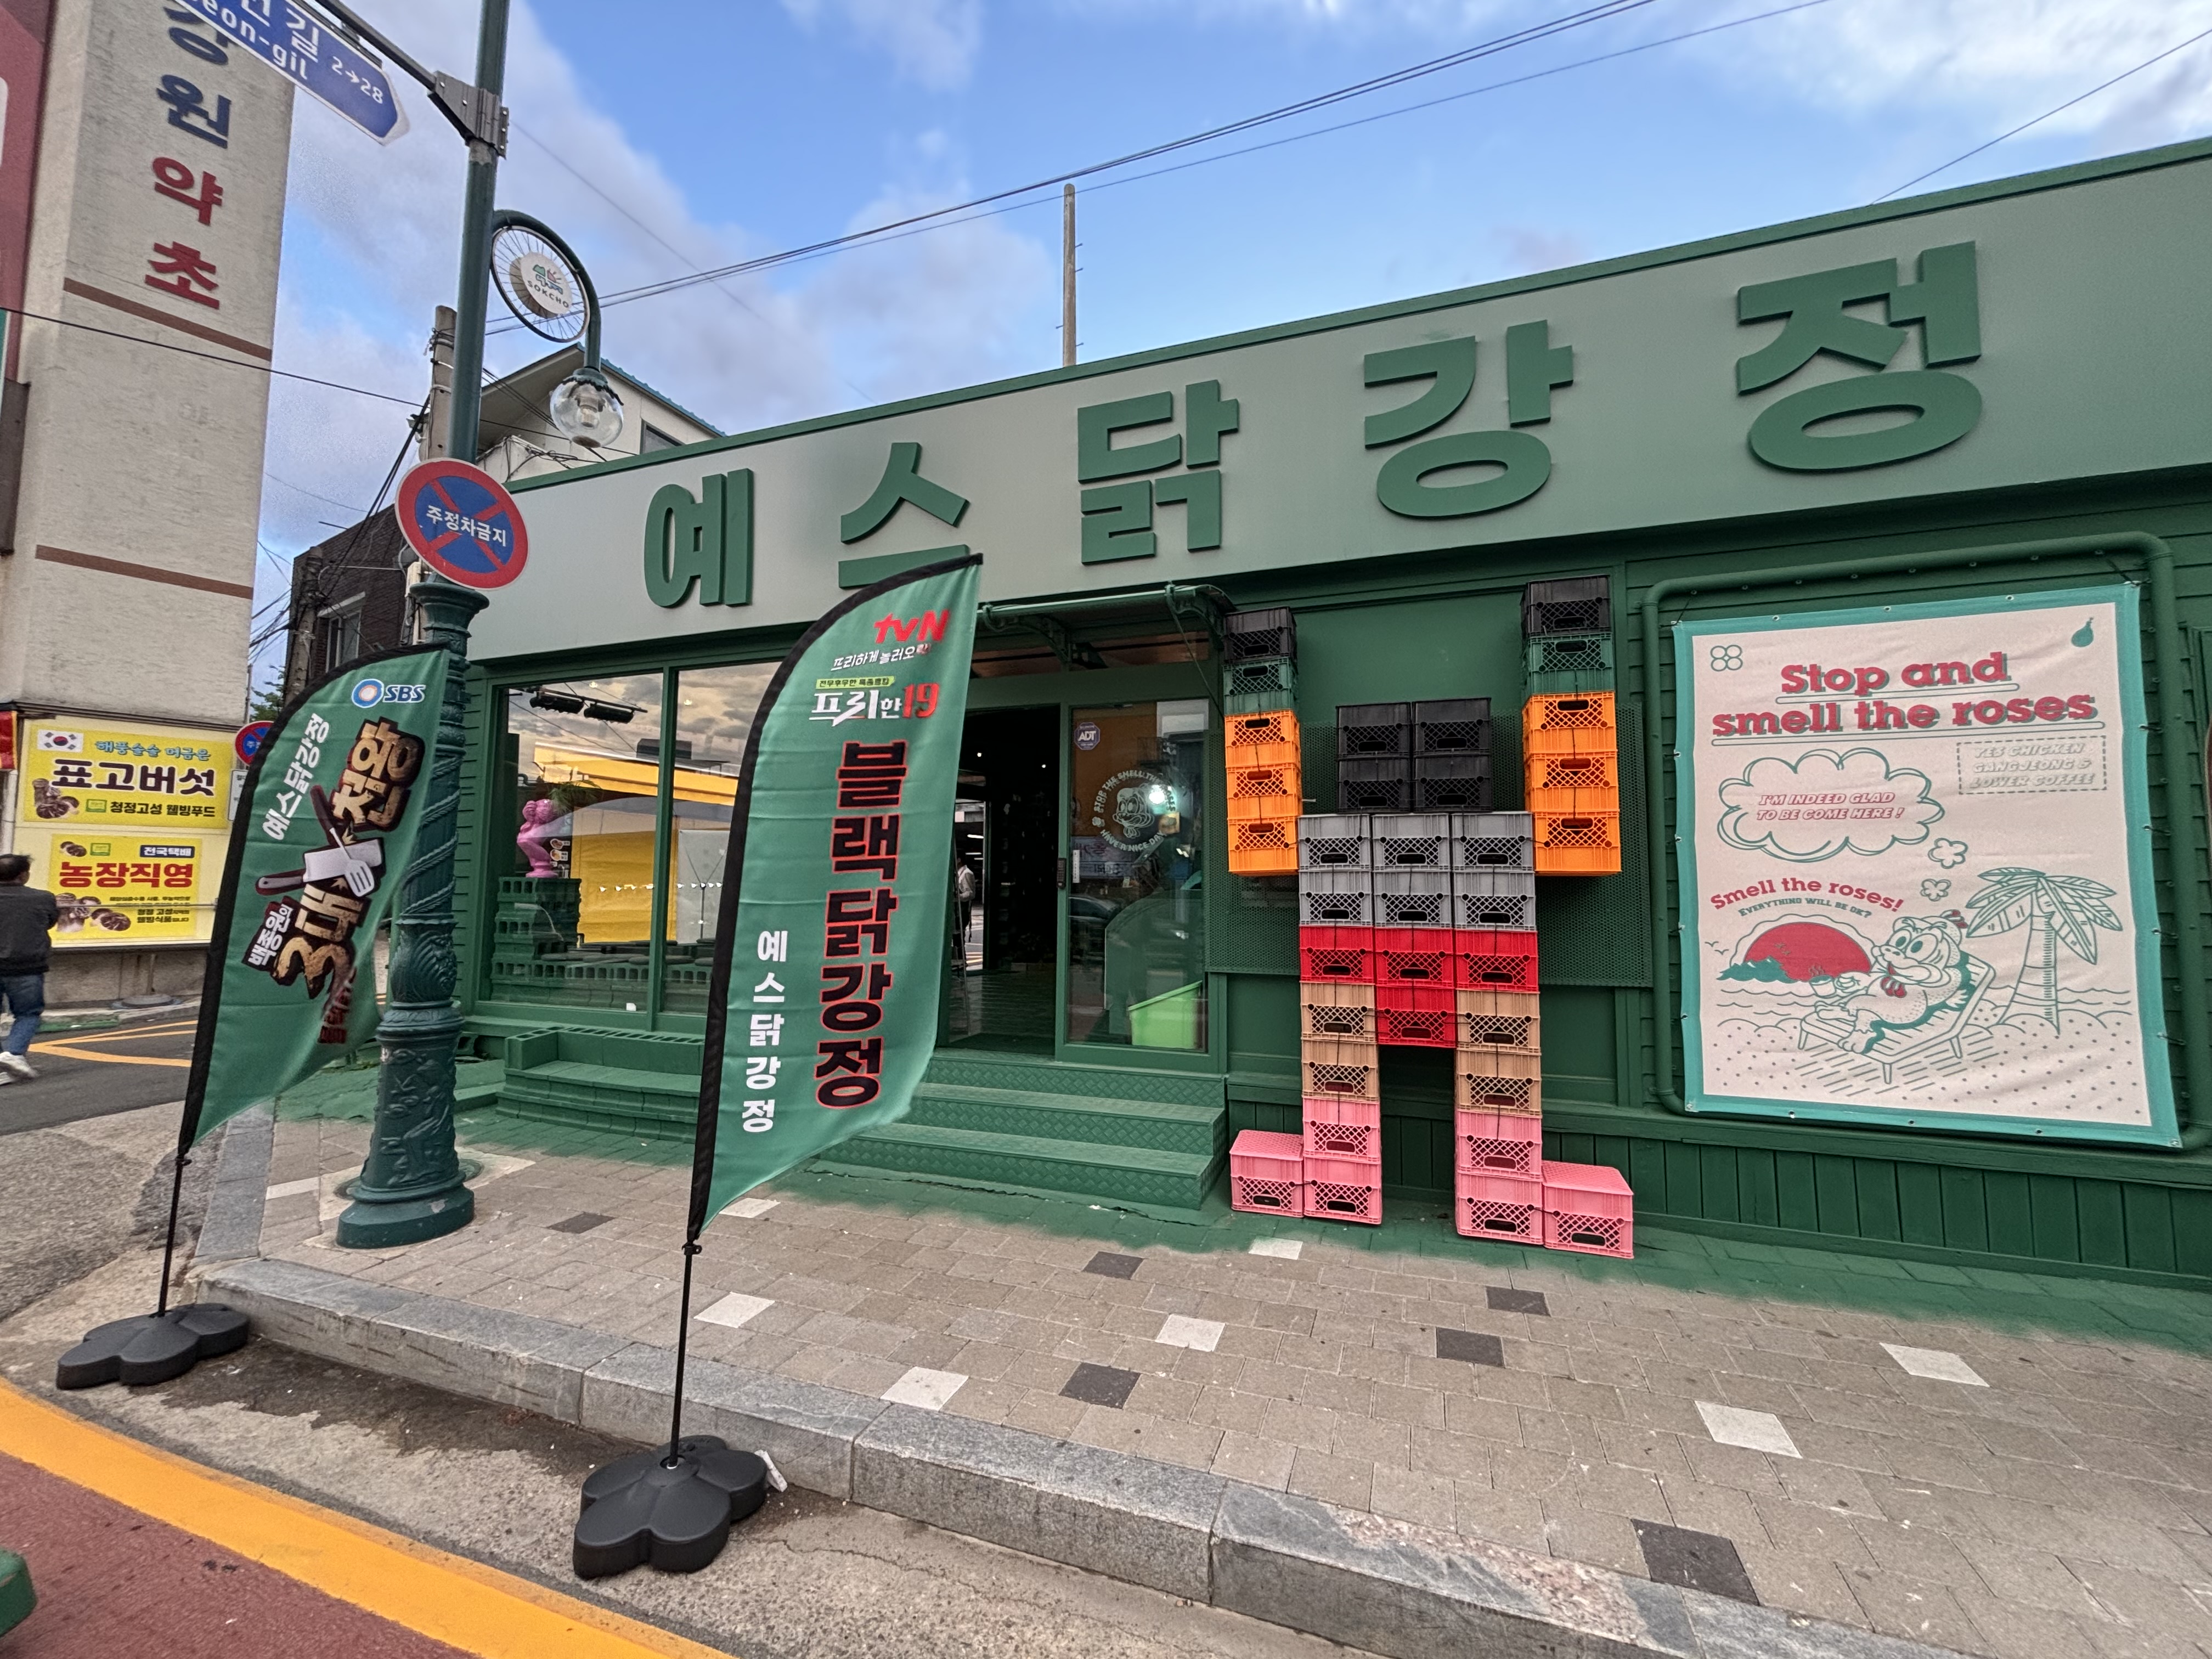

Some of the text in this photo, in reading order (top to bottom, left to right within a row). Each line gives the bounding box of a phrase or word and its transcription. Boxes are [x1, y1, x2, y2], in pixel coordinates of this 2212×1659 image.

[193, 0, 307, 80] eon-gil
[527, 280, 569, 308] SOKCHO
[426, 505, 506, 547] 주정차금지
[873, 609, 950, 644] tvN
[831, 650, 879, 672] 프리하게
[1781, 651, 2012, 697] Stop and
[383, 685, 425, 703] SBS
[1712, 694, 2098, 736] smell the roses
[1078, 731, 1096, 741] ADT
[165, 746, 211, 761] 머금은
[1975, 743, 2085, 758] YES CHICKEN
[51, 759, 215, 796] 표고버섯
[263, 713, 329, 840] 예스닭강정
[1974, 759, 2075, 774] GANGJEONG
[1102, 776, 1120, 792] THE
[1117, 770, 1144, 780] SMELL
[2032, 772, 2095, 787] COFFEE
[110, 802, 216, 817] 청정고성 웰빙푸드
[1758, 792, 1895, 805] I'M INDEED GLAD
[1757, 810, 1778, 820] TO
[1778, 809, 1800, 820] BE
[1802, 808, 1849, 820] COME
[1850, 808, 1893, 819] HERE
[144, 847, 192, 857] 전국택배
[1100, 830, 1119, 848] HAVE
[1128, 841, 1148, 852] NICE
[1149, 830, 1167, 845] DAY
[59, 861, 193, 888] 농장직영
[1710, 877, 1904, 912] Smell the roses!
[1737, 897, 1802, 917] EVERYTHING
[1805, 897, 1832, 907] WILL
[1834, 901, 1848, 910] BE
[247, 904, 294, 966] 백종원의
[814, 740, 909, 1109] 블랙닭강정
[742, 930, 788, 1133] 예스닭강정
